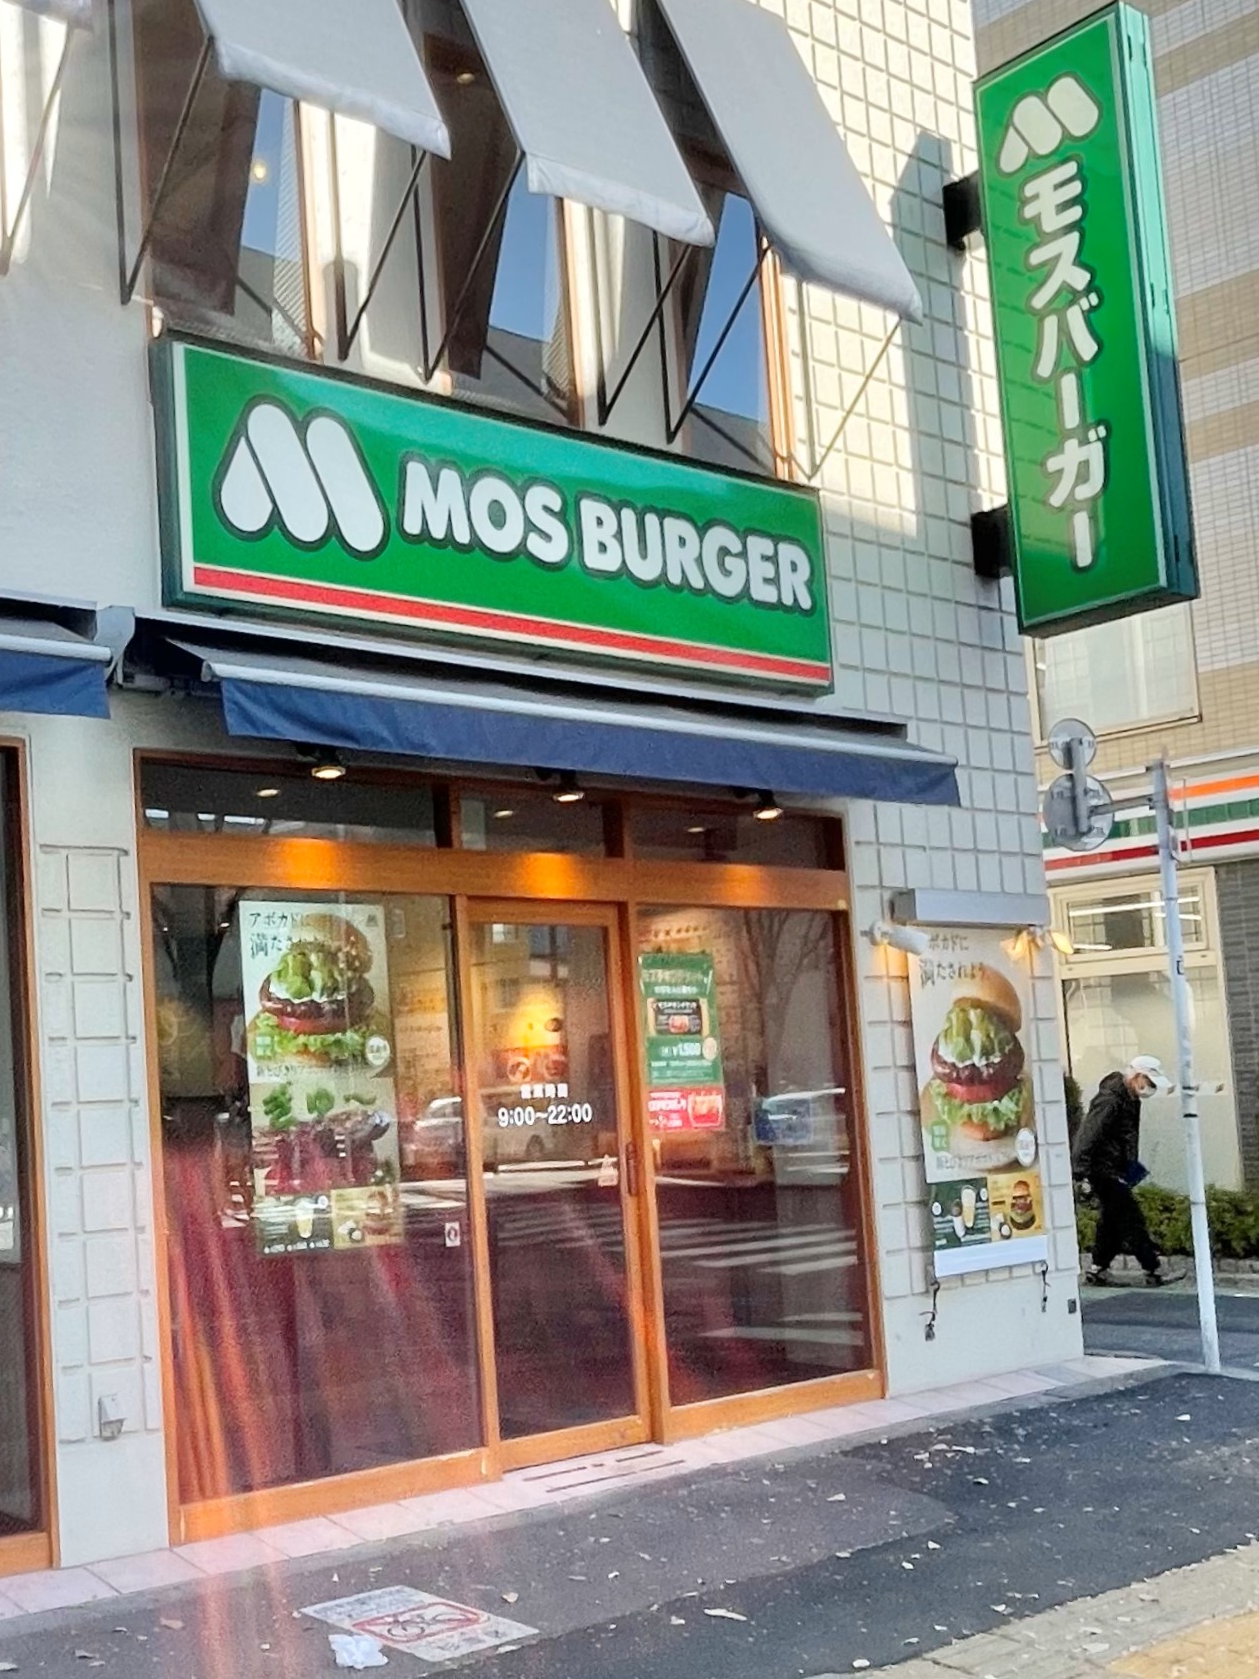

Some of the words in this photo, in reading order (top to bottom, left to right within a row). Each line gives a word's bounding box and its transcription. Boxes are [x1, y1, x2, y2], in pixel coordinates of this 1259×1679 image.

[1023, 160, 1107, 568] モスバーガー
[403, 460, 569, 564] MOS
[577, 497, 814, 611] BURGER
